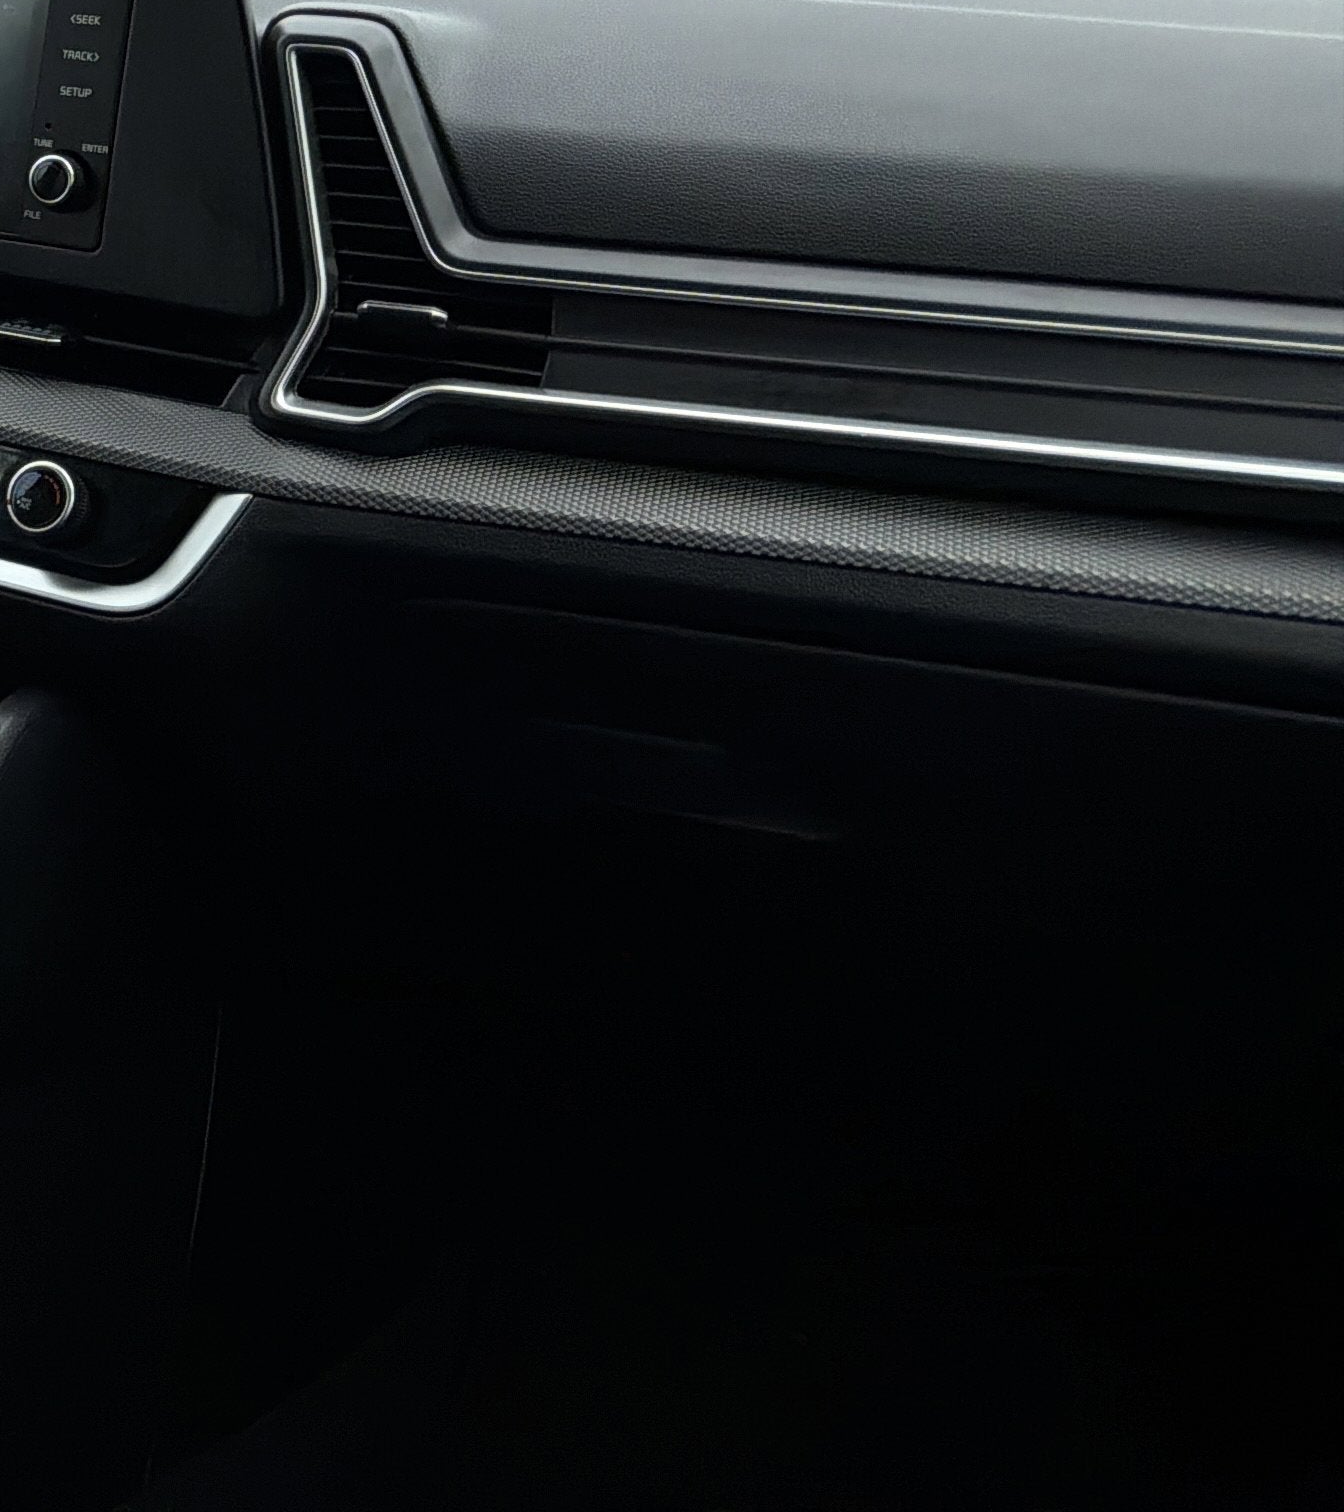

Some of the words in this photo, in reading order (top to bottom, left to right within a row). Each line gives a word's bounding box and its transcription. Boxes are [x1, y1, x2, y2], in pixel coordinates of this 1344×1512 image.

[59, 85, 92, 98] SETUP
[33, 138, 54, 148] TUNE
[81, 144, 108, 154] ENTER
[23, 209, 41, 220] FILE
